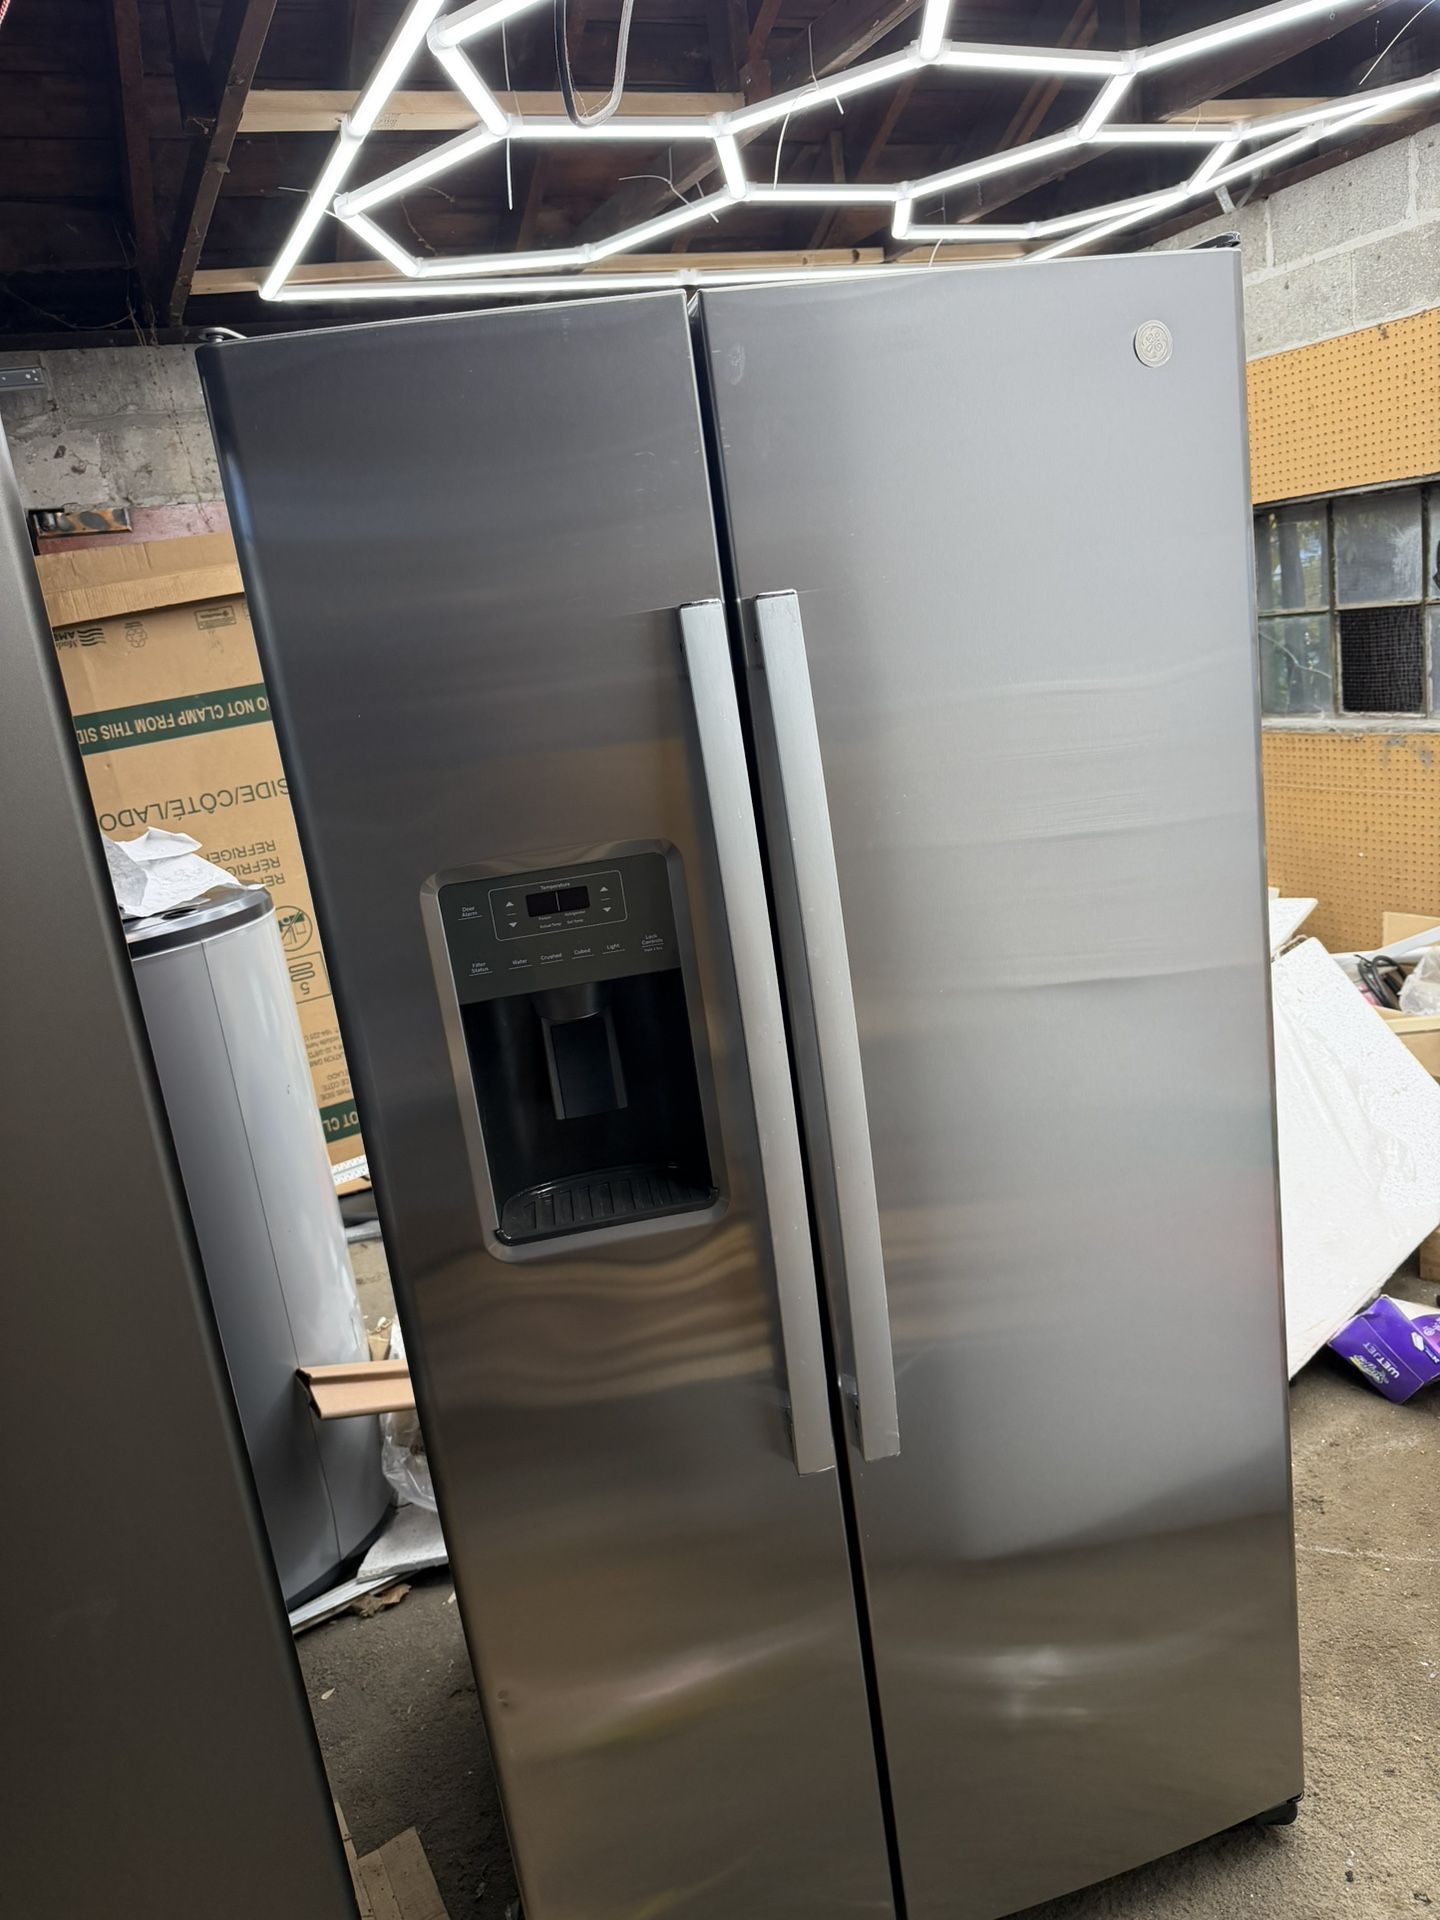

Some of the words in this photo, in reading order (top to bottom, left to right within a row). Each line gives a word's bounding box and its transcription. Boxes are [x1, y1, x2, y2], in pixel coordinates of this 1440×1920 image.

[227, 699, 256, 718] NOT
[256, 696, 271, 712] O
[135, 713, 176, 734] FROM
[178, 704, 224, 726] CLAMP
[101, 721, 134, 741] THIS
[300, 982, 310, 995] 5
